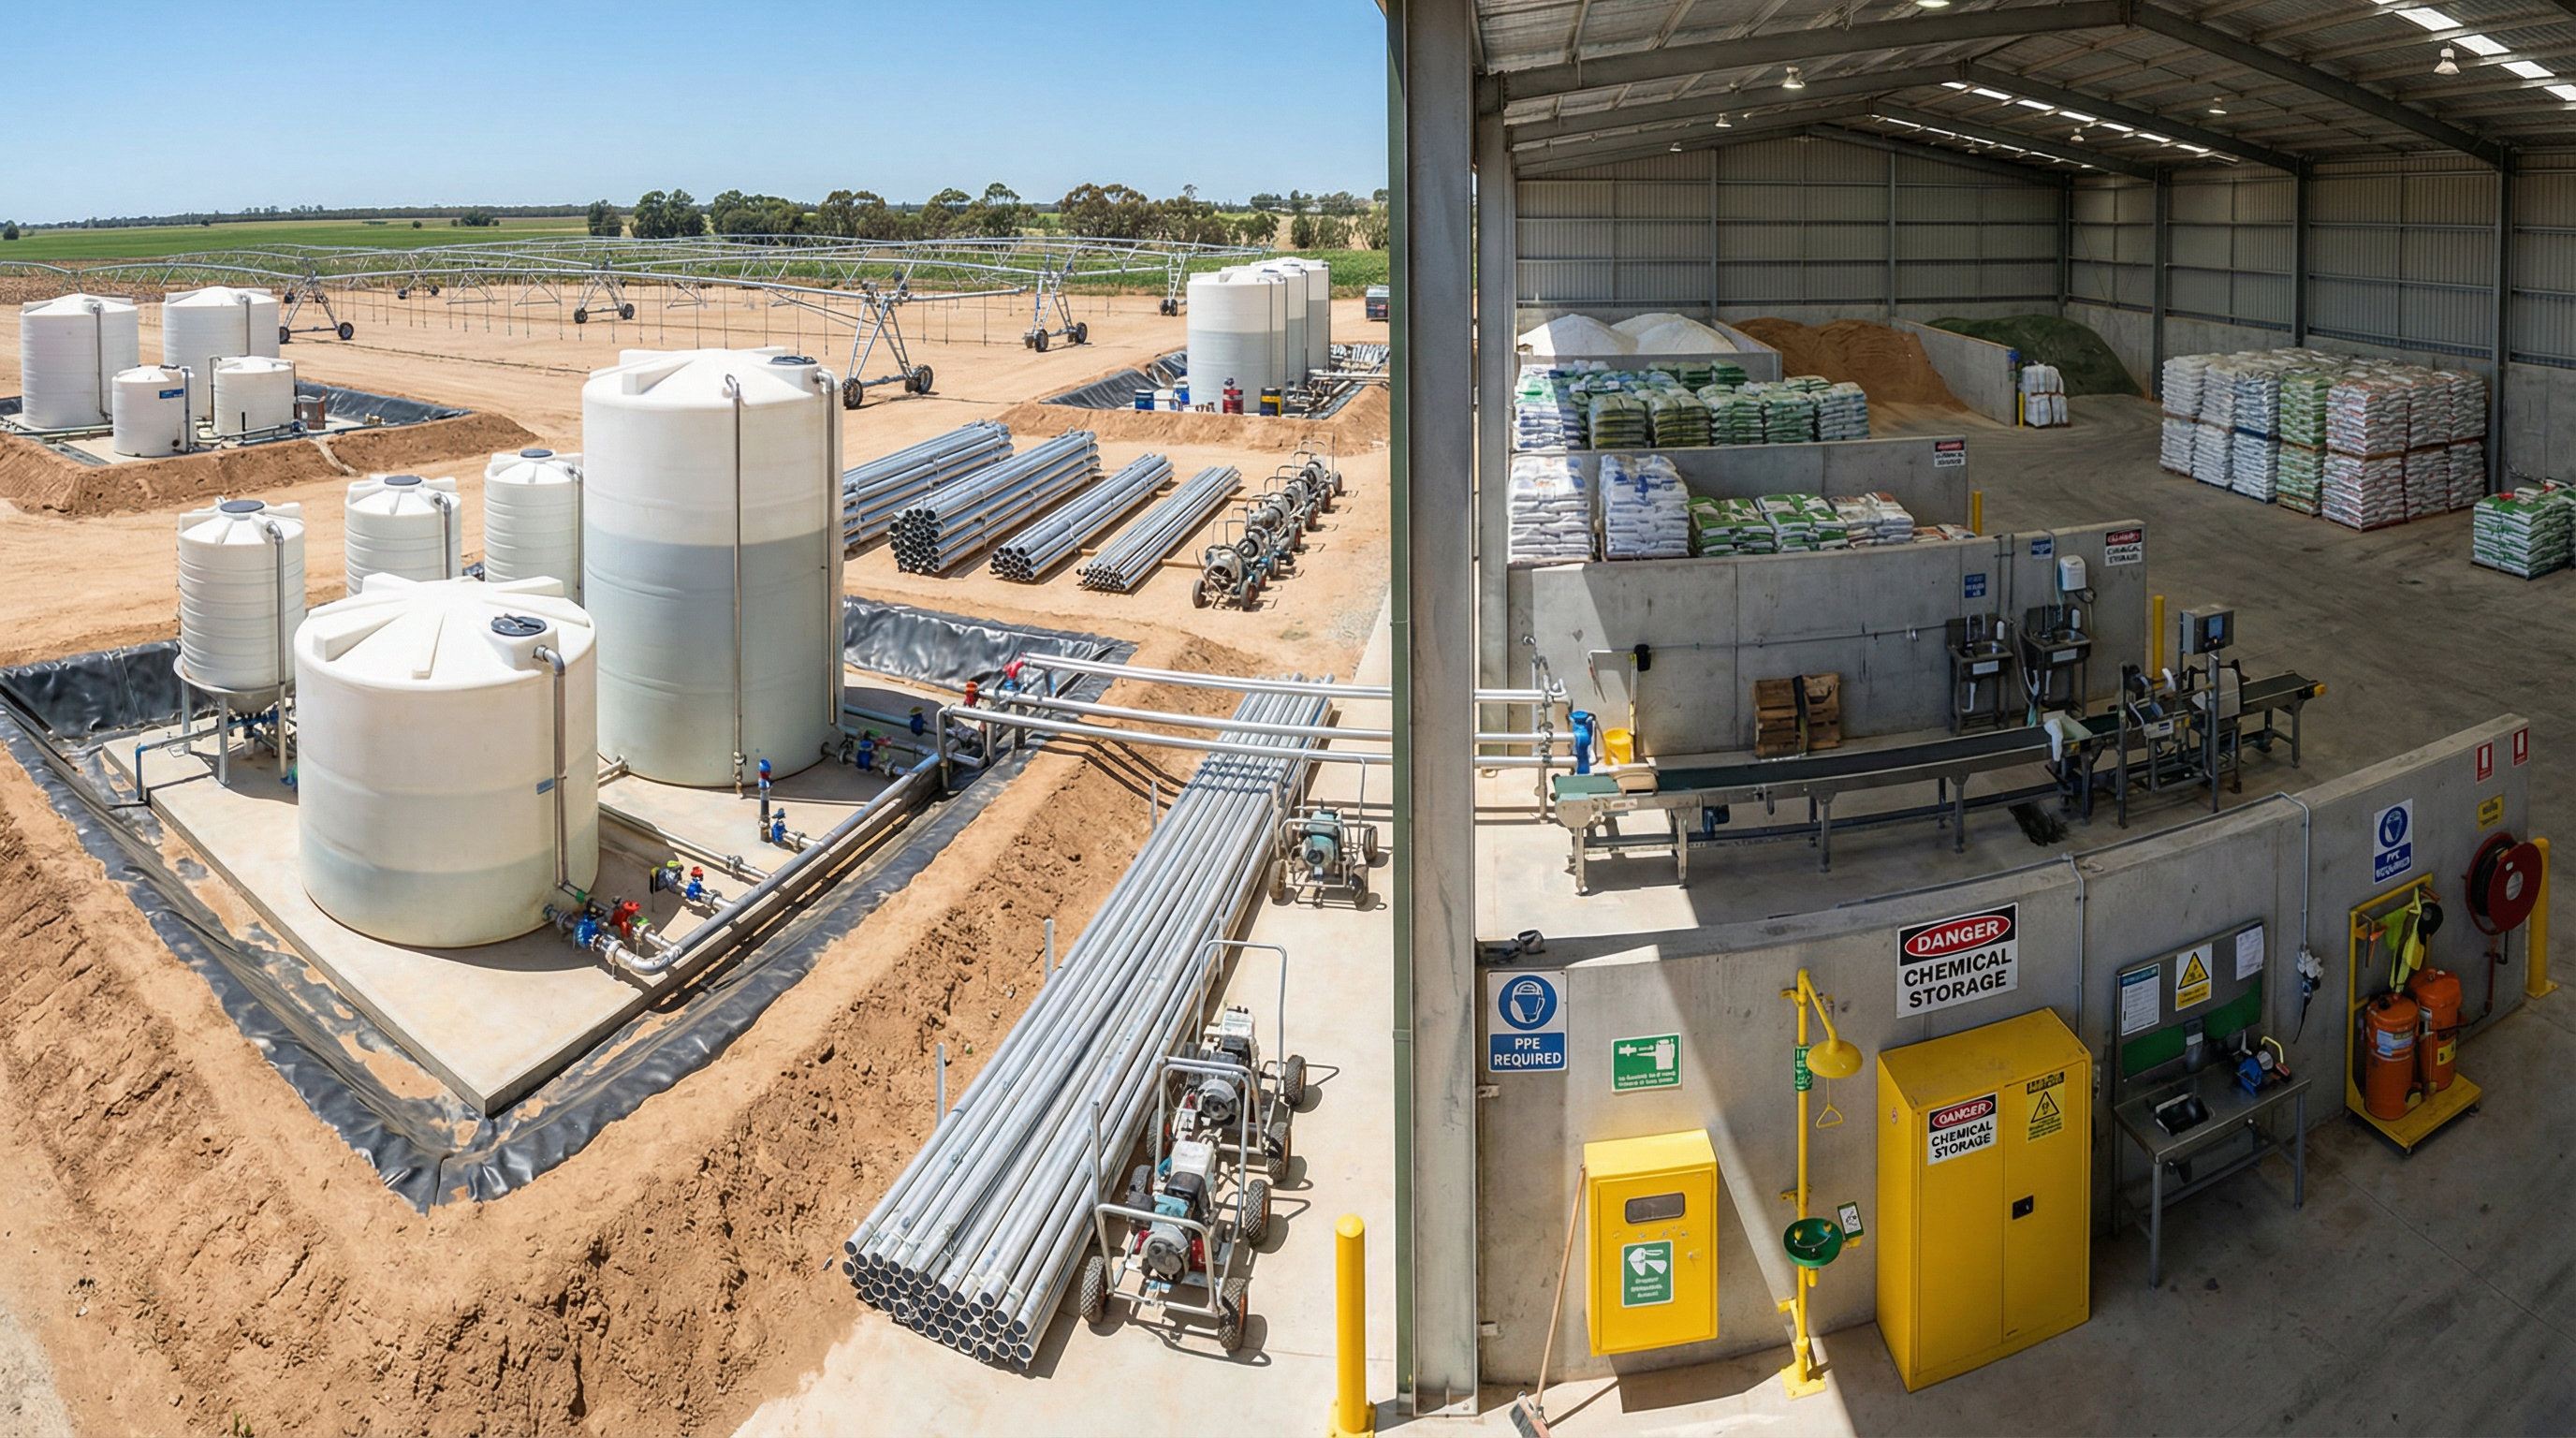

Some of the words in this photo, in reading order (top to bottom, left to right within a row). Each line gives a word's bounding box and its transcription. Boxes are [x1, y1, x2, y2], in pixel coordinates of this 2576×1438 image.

[1917, 920, 1999, 952] DANGER
[1904, 947, 2012, 987] CHEMICAL
[1909, 969, 2007, 1008] STORAGE
[1515, 1037, 1541, 1050] PPE
[1494, 1052, 1561, 1067] REQUIRED
[1931, 1121, 1993, 1147] CHEMICAL
